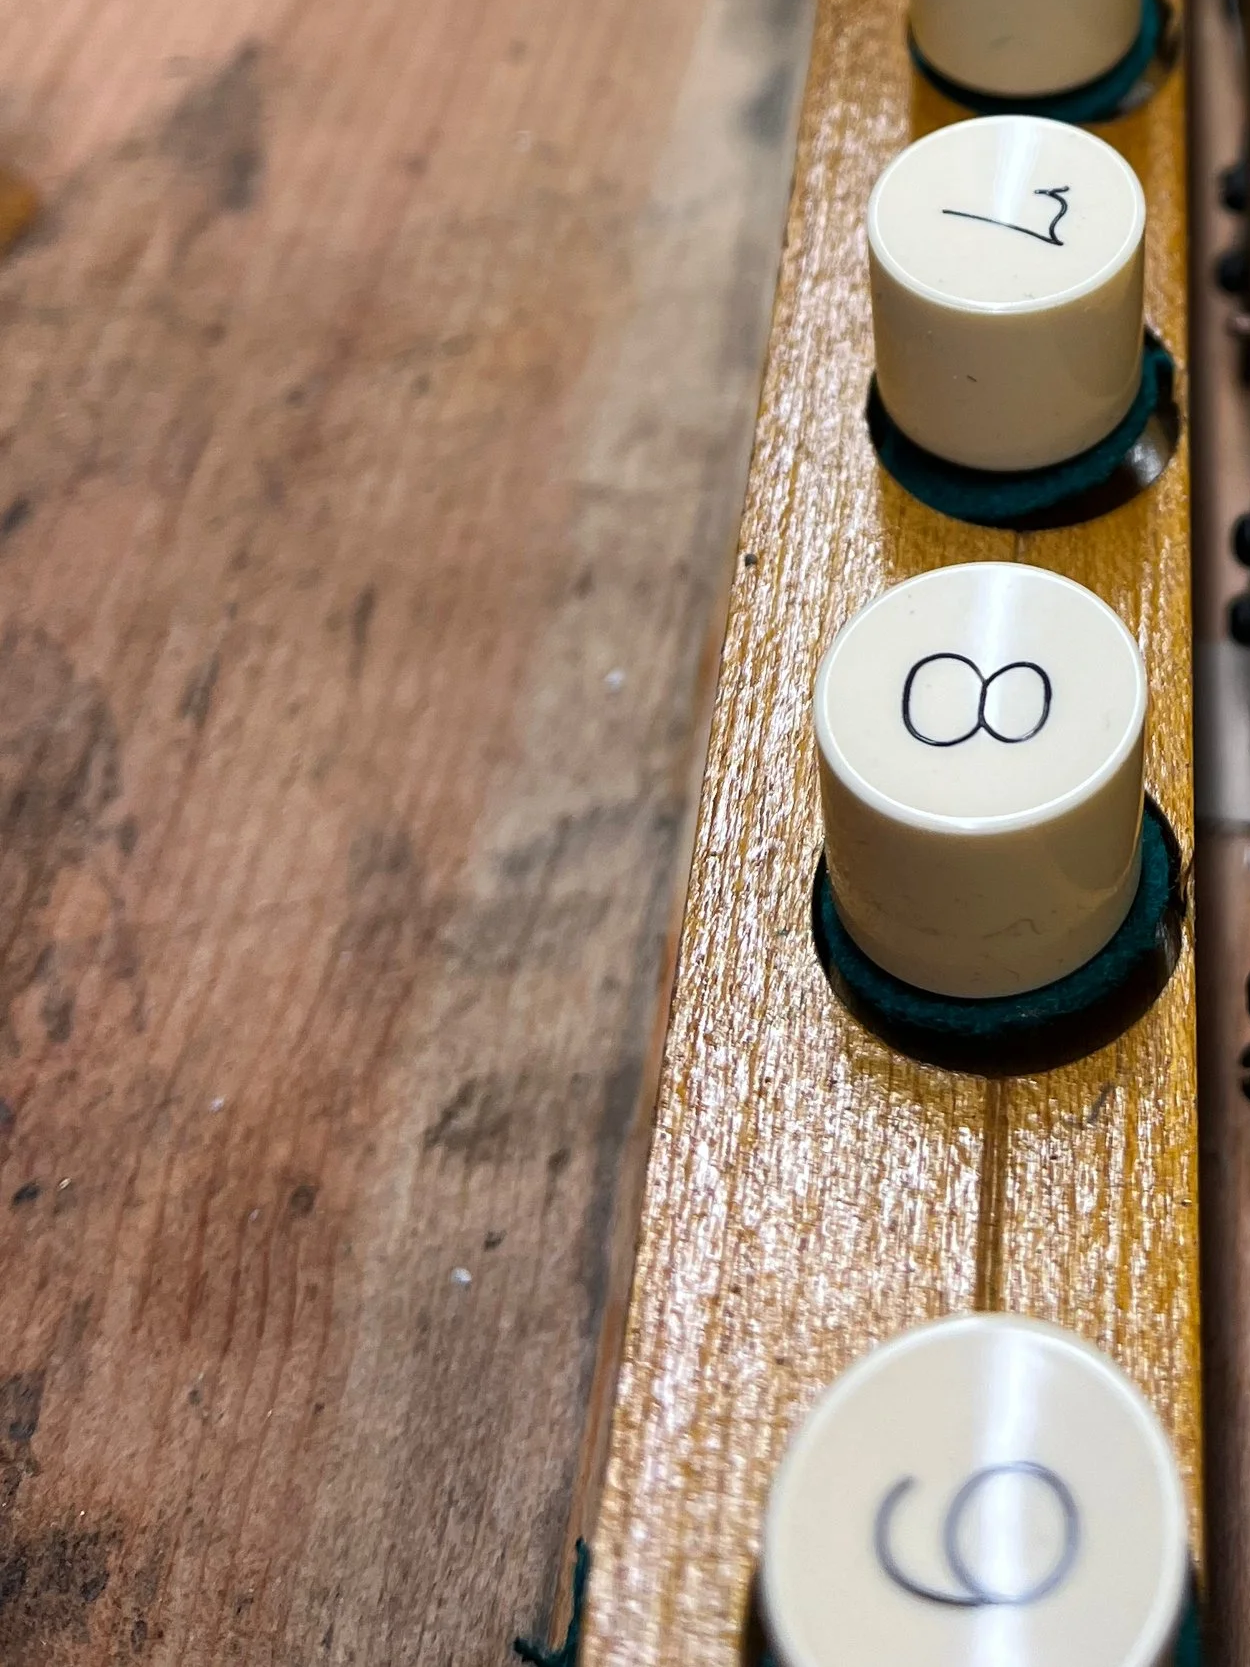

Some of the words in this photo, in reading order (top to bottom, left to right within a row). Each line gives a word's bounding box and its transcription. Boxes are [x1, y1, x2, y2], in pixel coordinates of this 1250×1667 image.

[943, 187, 1069, 246] 7
[902, 653, 1052, 747] 8
[873, 1462, 1082, 1611] 9
